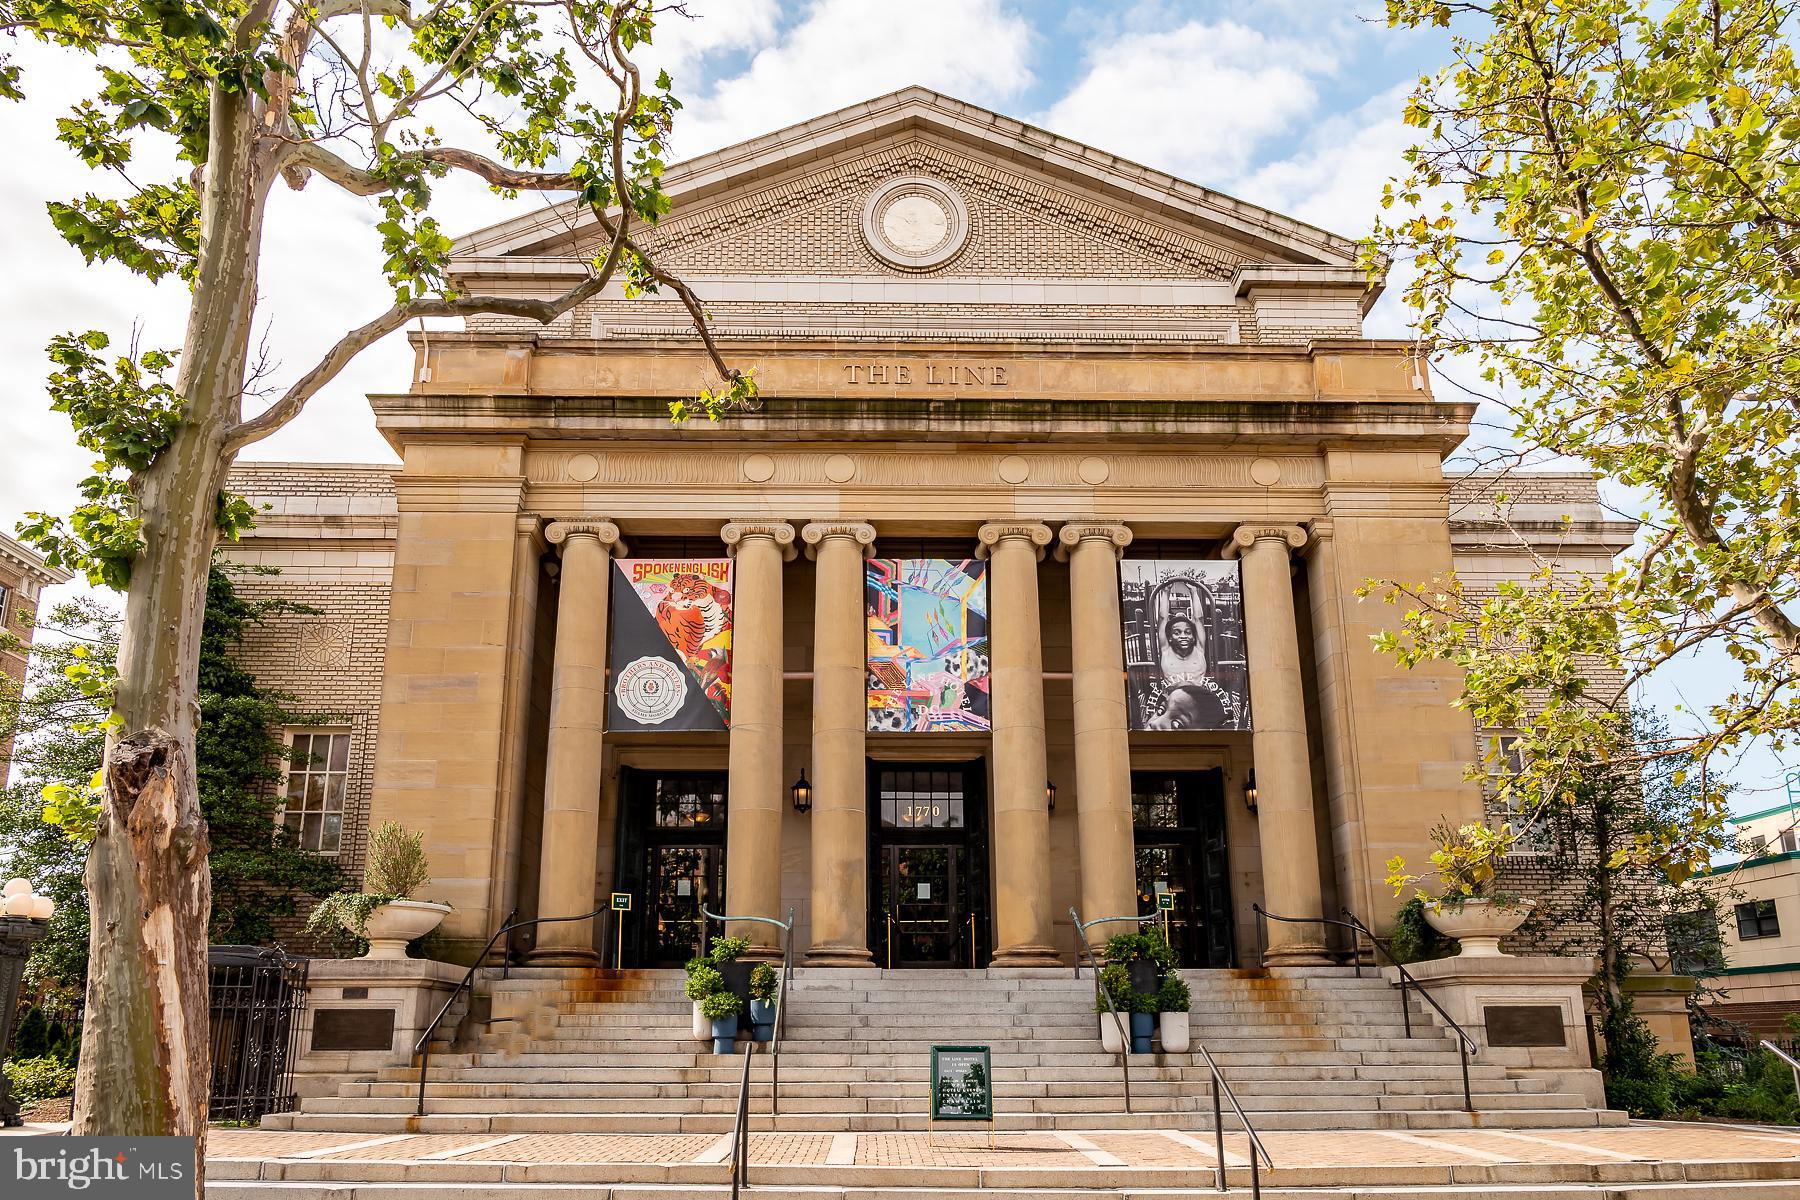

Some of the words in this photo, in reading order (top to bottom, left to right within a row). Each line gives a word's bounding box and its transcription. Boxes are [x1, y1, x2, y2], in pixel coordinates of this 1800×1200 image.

[843, 365, 912, 385] THE
[926, 365, 1008, 386] LINE
[620, 662, 647, 693] BROTHERS
[666, 667, 681, 694] SISTERS
[885, 688, 902, 715] THE
[902, 674, 935, 689] LINE
[941, 676, 972, 712] HOTEL
[1145, 686, 1163, 715] THE
[1160, 673, 1194, 689] LINE
[1200, 675, 1233, 715] HOTEL
[917, 704, 940, 715] DC
[907, 805, 940, 817] 1770
